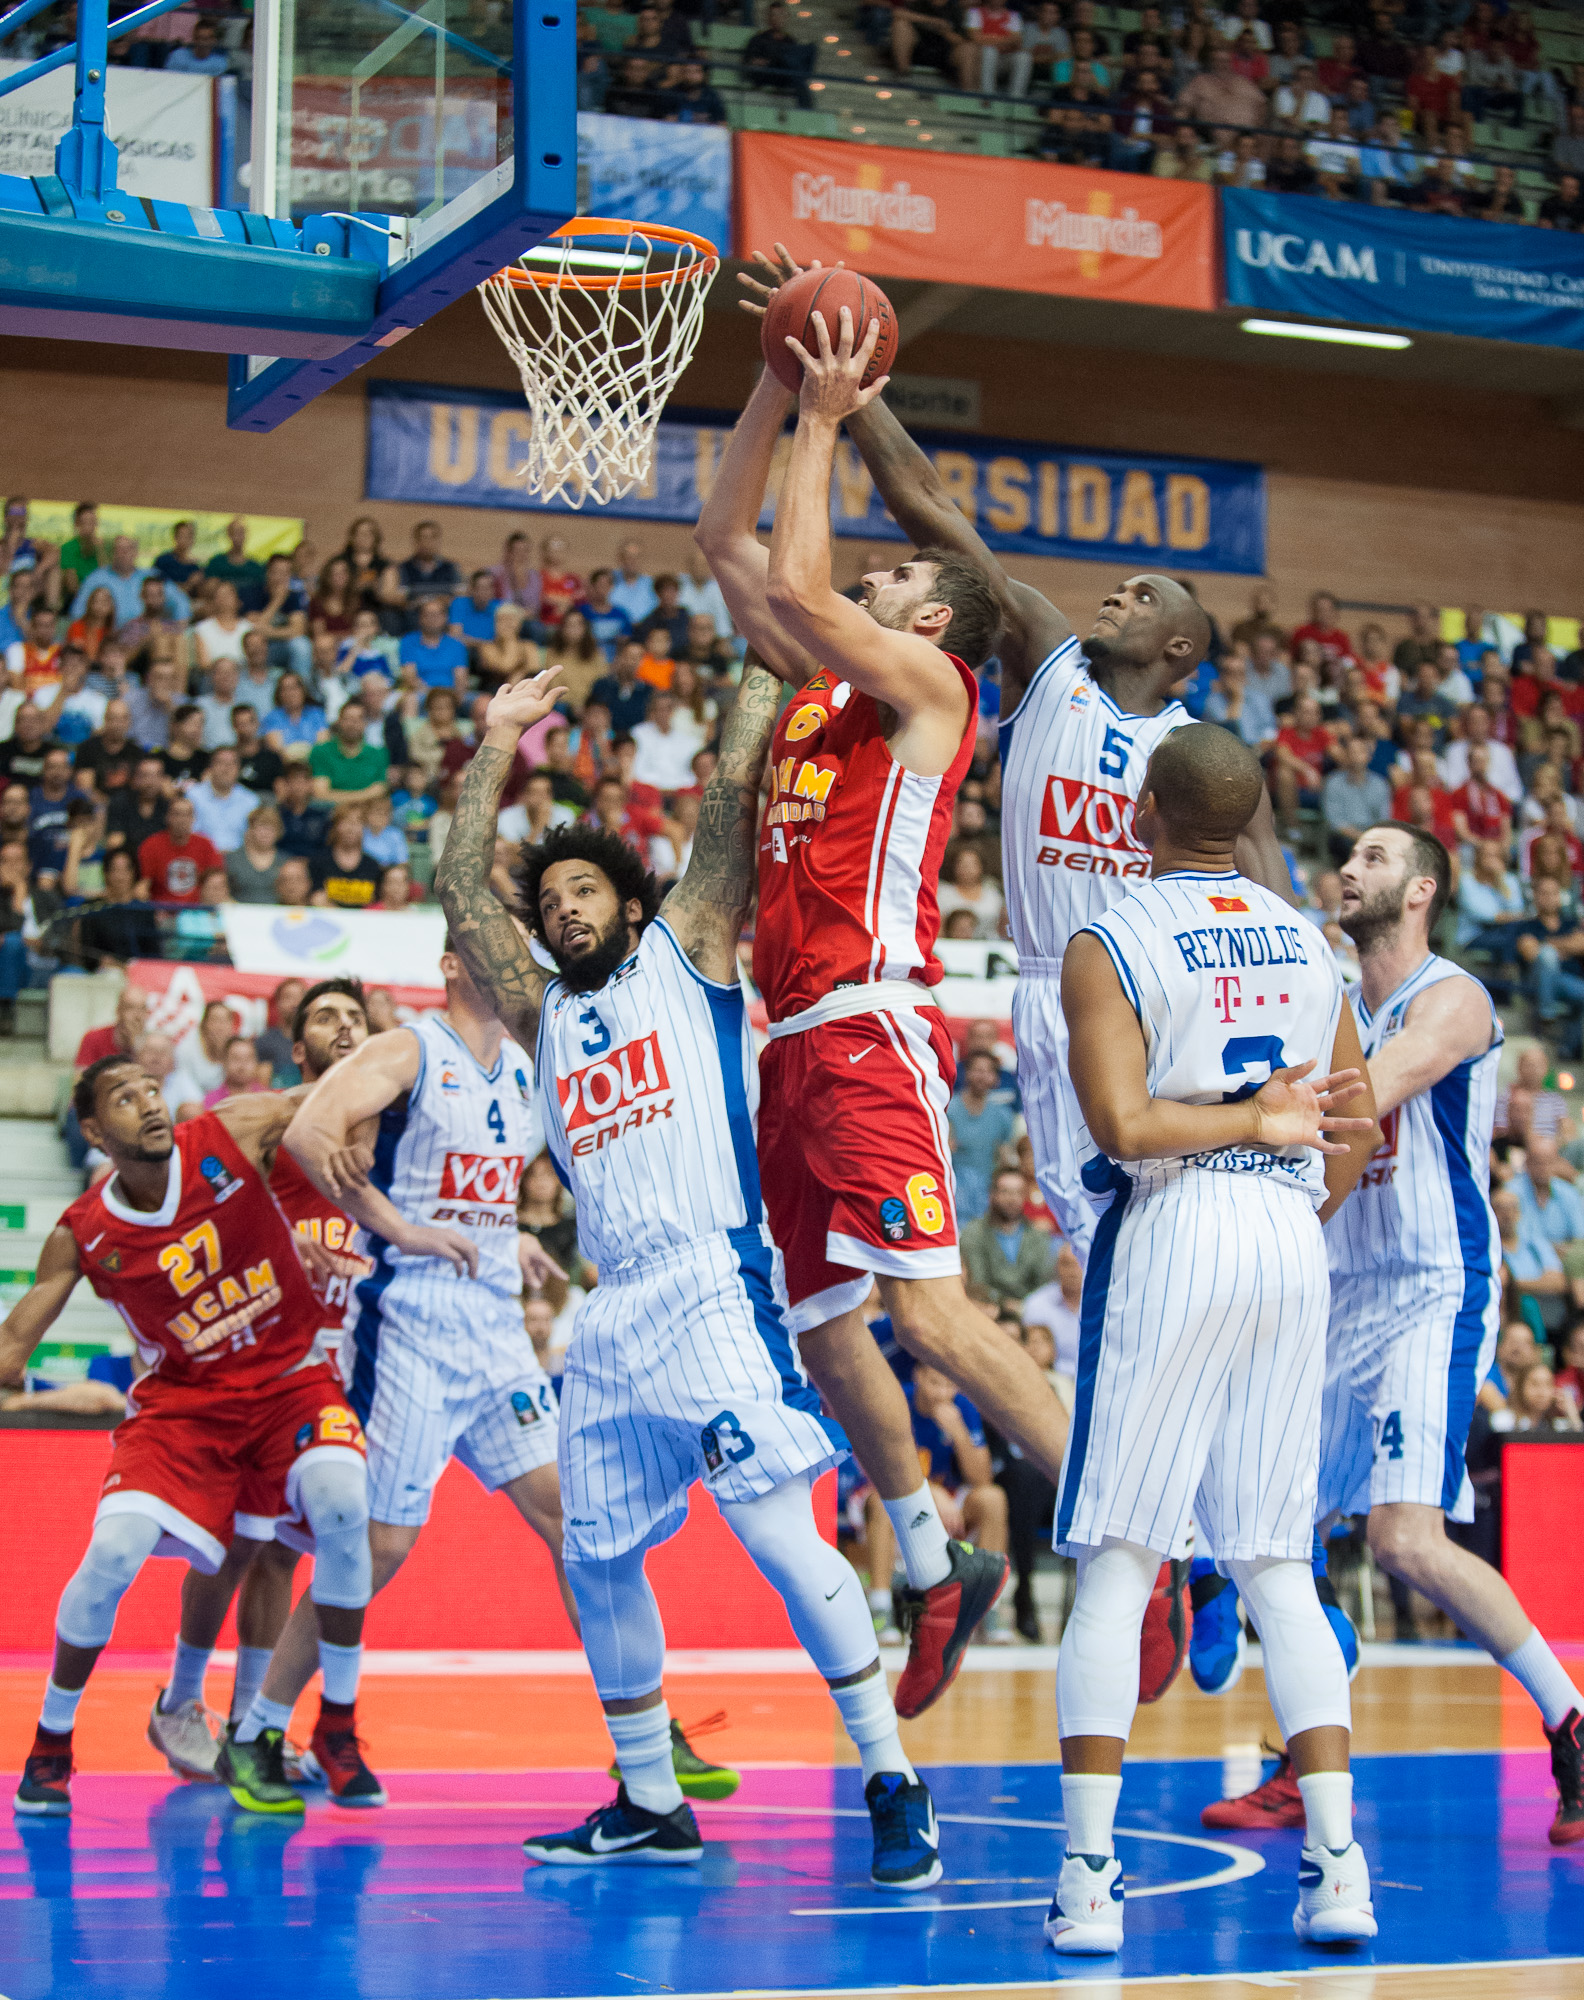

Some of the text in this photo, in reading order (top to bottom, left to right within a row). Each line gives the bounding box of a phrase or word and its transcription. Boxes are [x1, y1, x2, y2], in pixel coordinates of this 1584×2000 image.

[792, 172, 936, 233] Murcia
[1026, 198, 1163, 258] Murcia
[1235, 228, 1379, 283] UCAM
[785, 703, 828, 742] 6
[1099, 723, 1134, 779] 5
[1036, 846, 1151, 879] BEMA
[1173, 925, 1308, 973] REYNOLDS
[579, 1005, 612, 1057] 3
[486, 1099, 506, 1144] 4
[571, 1098, 674, 1158] EMAX
[450, 1154, 519, 1203] VOL
[905, 1171, 946, 1236] 6
[431, 1207, 518, 1228] BEMA
[157, 1218, 223, 1298] 27
[165, 1257, 278, 1343] UCAM
[707, 1409, 756, 1464] 3
[1380, 1410, 1404, 1459] 4
